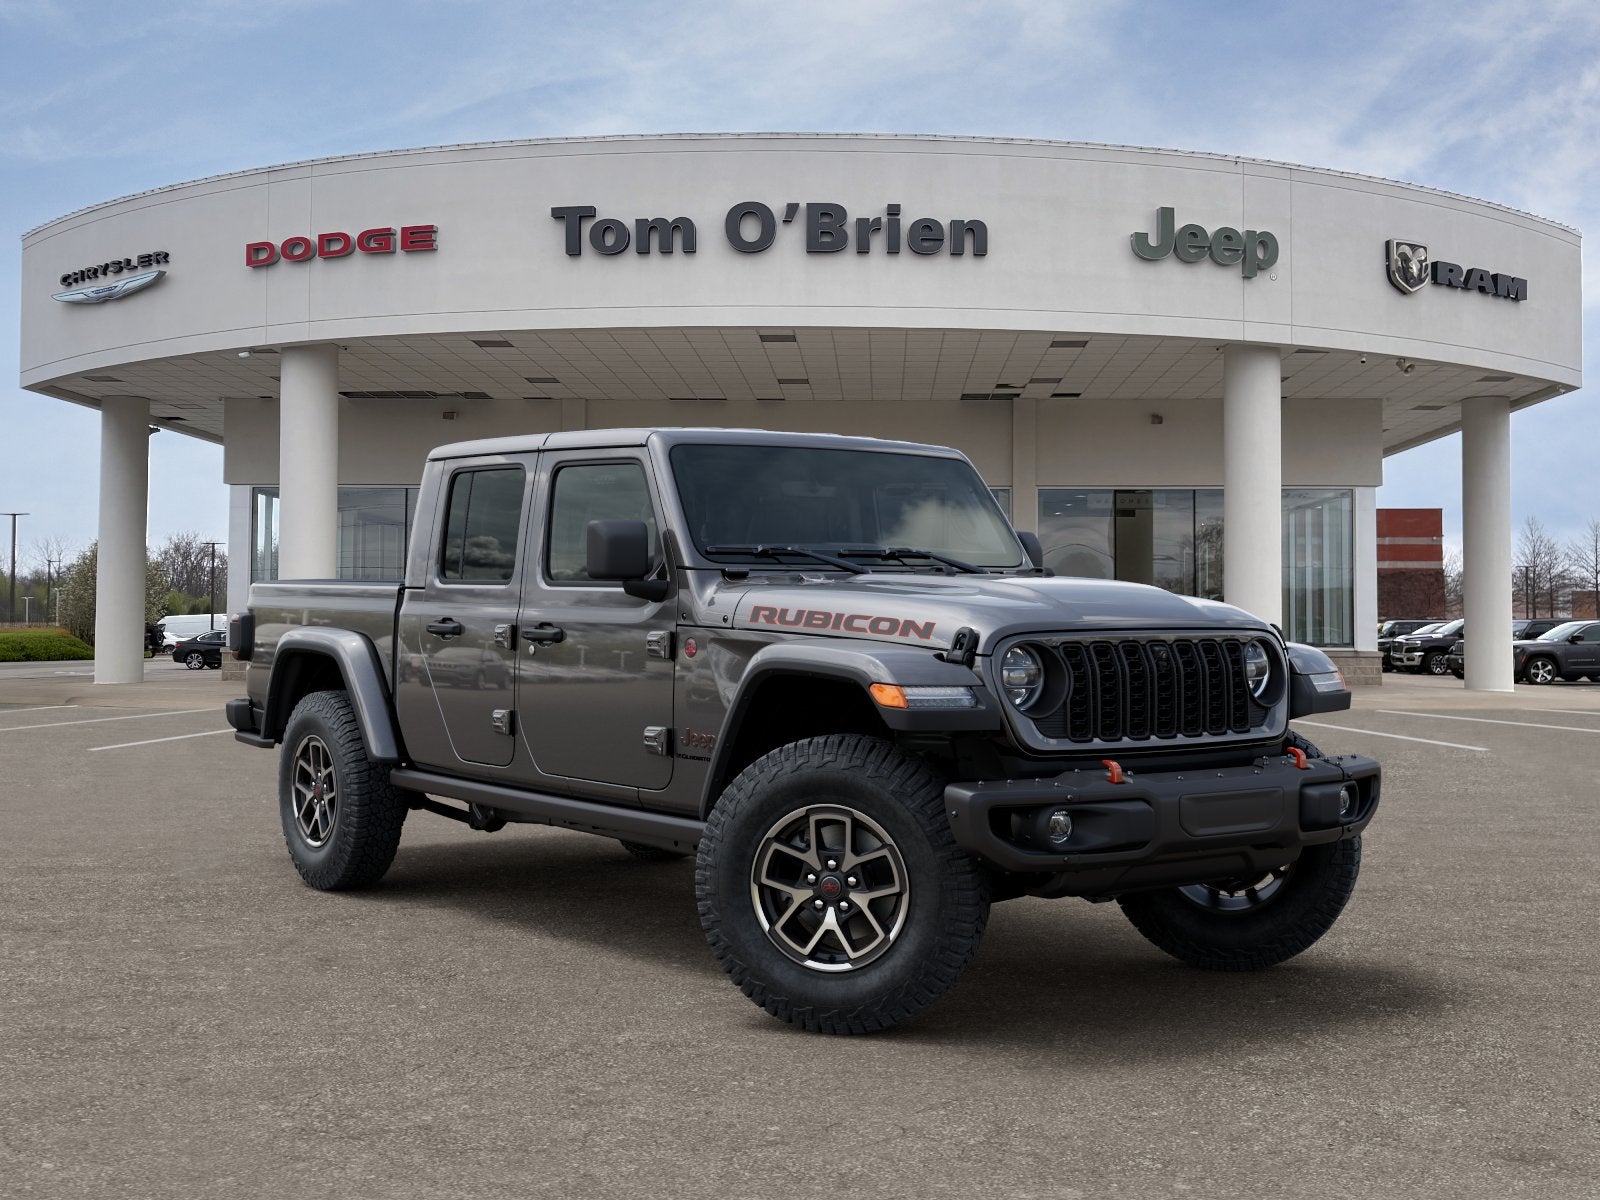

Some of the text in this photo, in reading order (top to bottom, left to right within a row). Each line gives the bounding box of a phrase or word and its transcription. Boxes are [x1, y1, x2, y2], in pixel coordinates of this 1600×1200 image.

[245, 224, 438, 268] DODGE
[551, 201, 988, 257] Tom O'Brien
[1131, 206, 1279, 279] Jeep
[59, 250, 170, 287] CHRYSLER
[1431, 260, 1528, 302] RAM
[750, 605, 936, 640] RUBICON
[680, 727, 716, 753] Jeep
